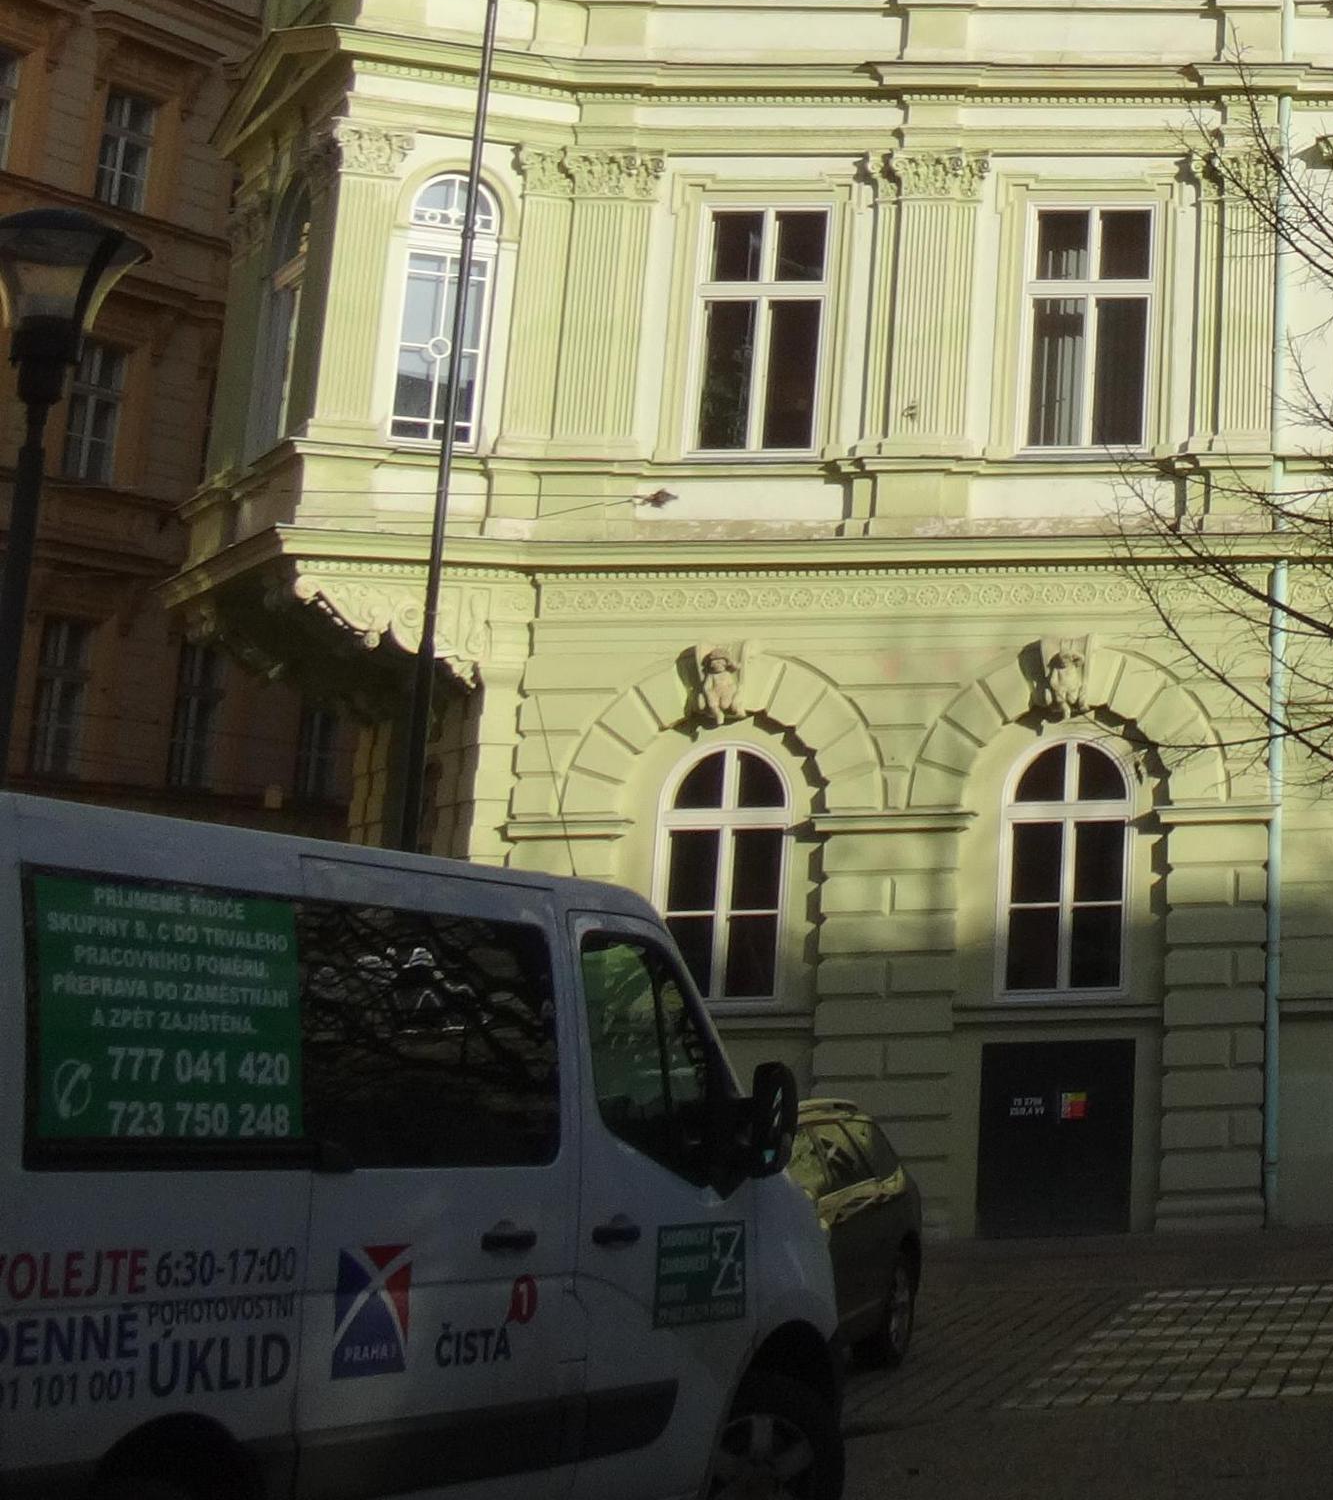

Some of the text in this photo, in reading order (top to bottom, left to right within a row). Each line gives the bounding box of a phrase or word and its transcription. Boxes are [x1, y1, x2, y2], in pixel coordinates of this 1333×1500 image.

[157, 921, 170, 942] C
[174, 924, 198, 943] DO
[154, 980, 178, 1000] DO
[91, 1007, 105, 1027] A
[108, 1046, 290, 1086] 777 041 420
[108, 1101, 290, 1138] 723 750 248
[156, 1247, 297, 1288] 6:30-17:00
[149, 1329, 291, 1398] ÚKLID
[33, 1373, 78, 1409] 101
[89, 1368, 136, 1402] 001
